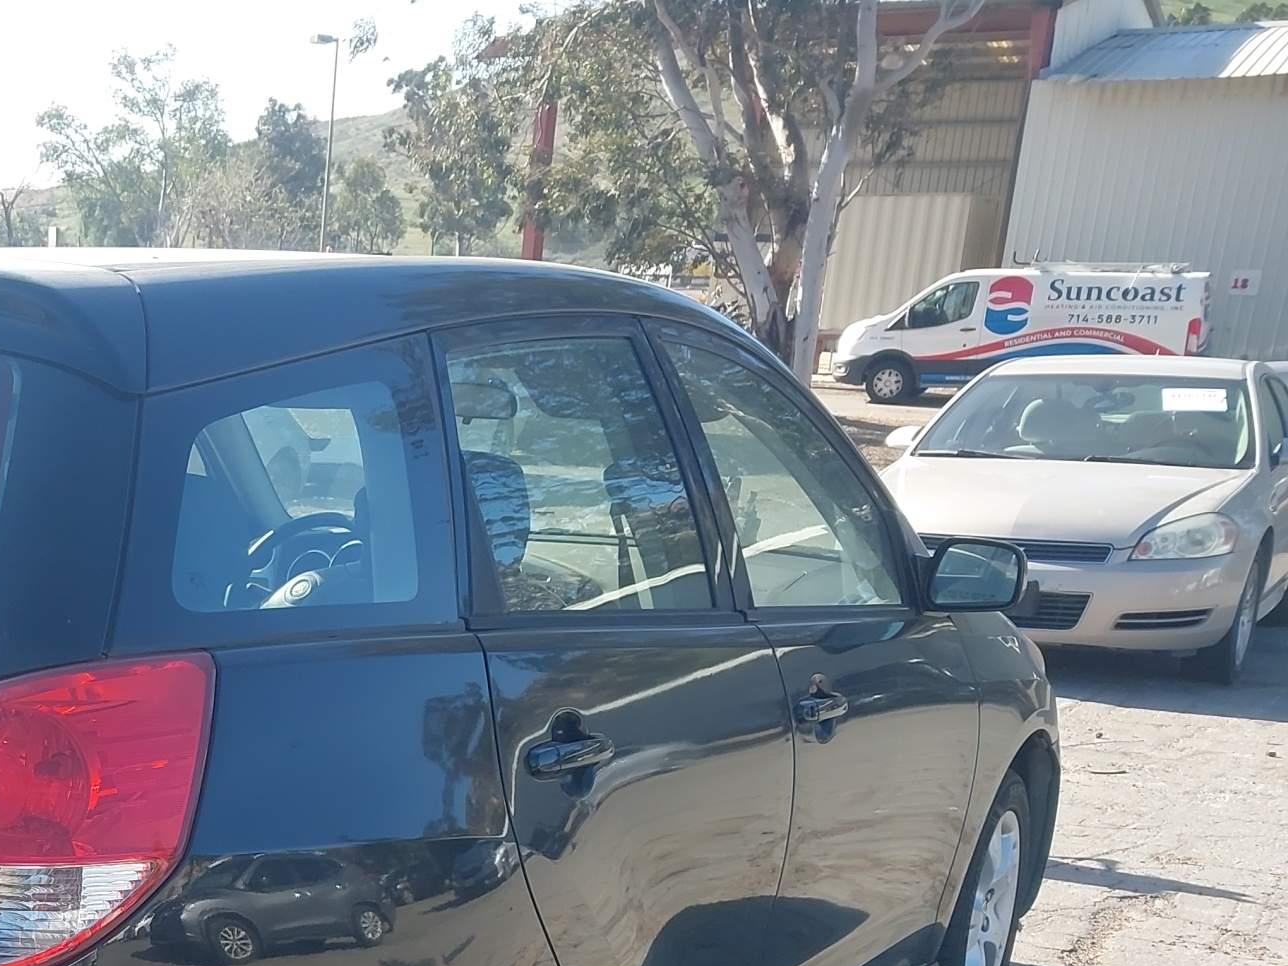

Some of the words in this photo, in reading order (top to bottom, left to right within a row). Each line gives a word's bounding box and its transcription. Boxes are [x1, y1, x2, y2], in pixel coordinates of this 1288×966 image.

[1047, 278, 1187, 302] Suncoast
[1068, 313, 1159, 325] 714-588-3711
[1004, 331, 1052, 347] RESIDENTIAL
[1054, 330, 1072, 338] AND
[1073, 329, 1125, 342] COMMERCIAL
